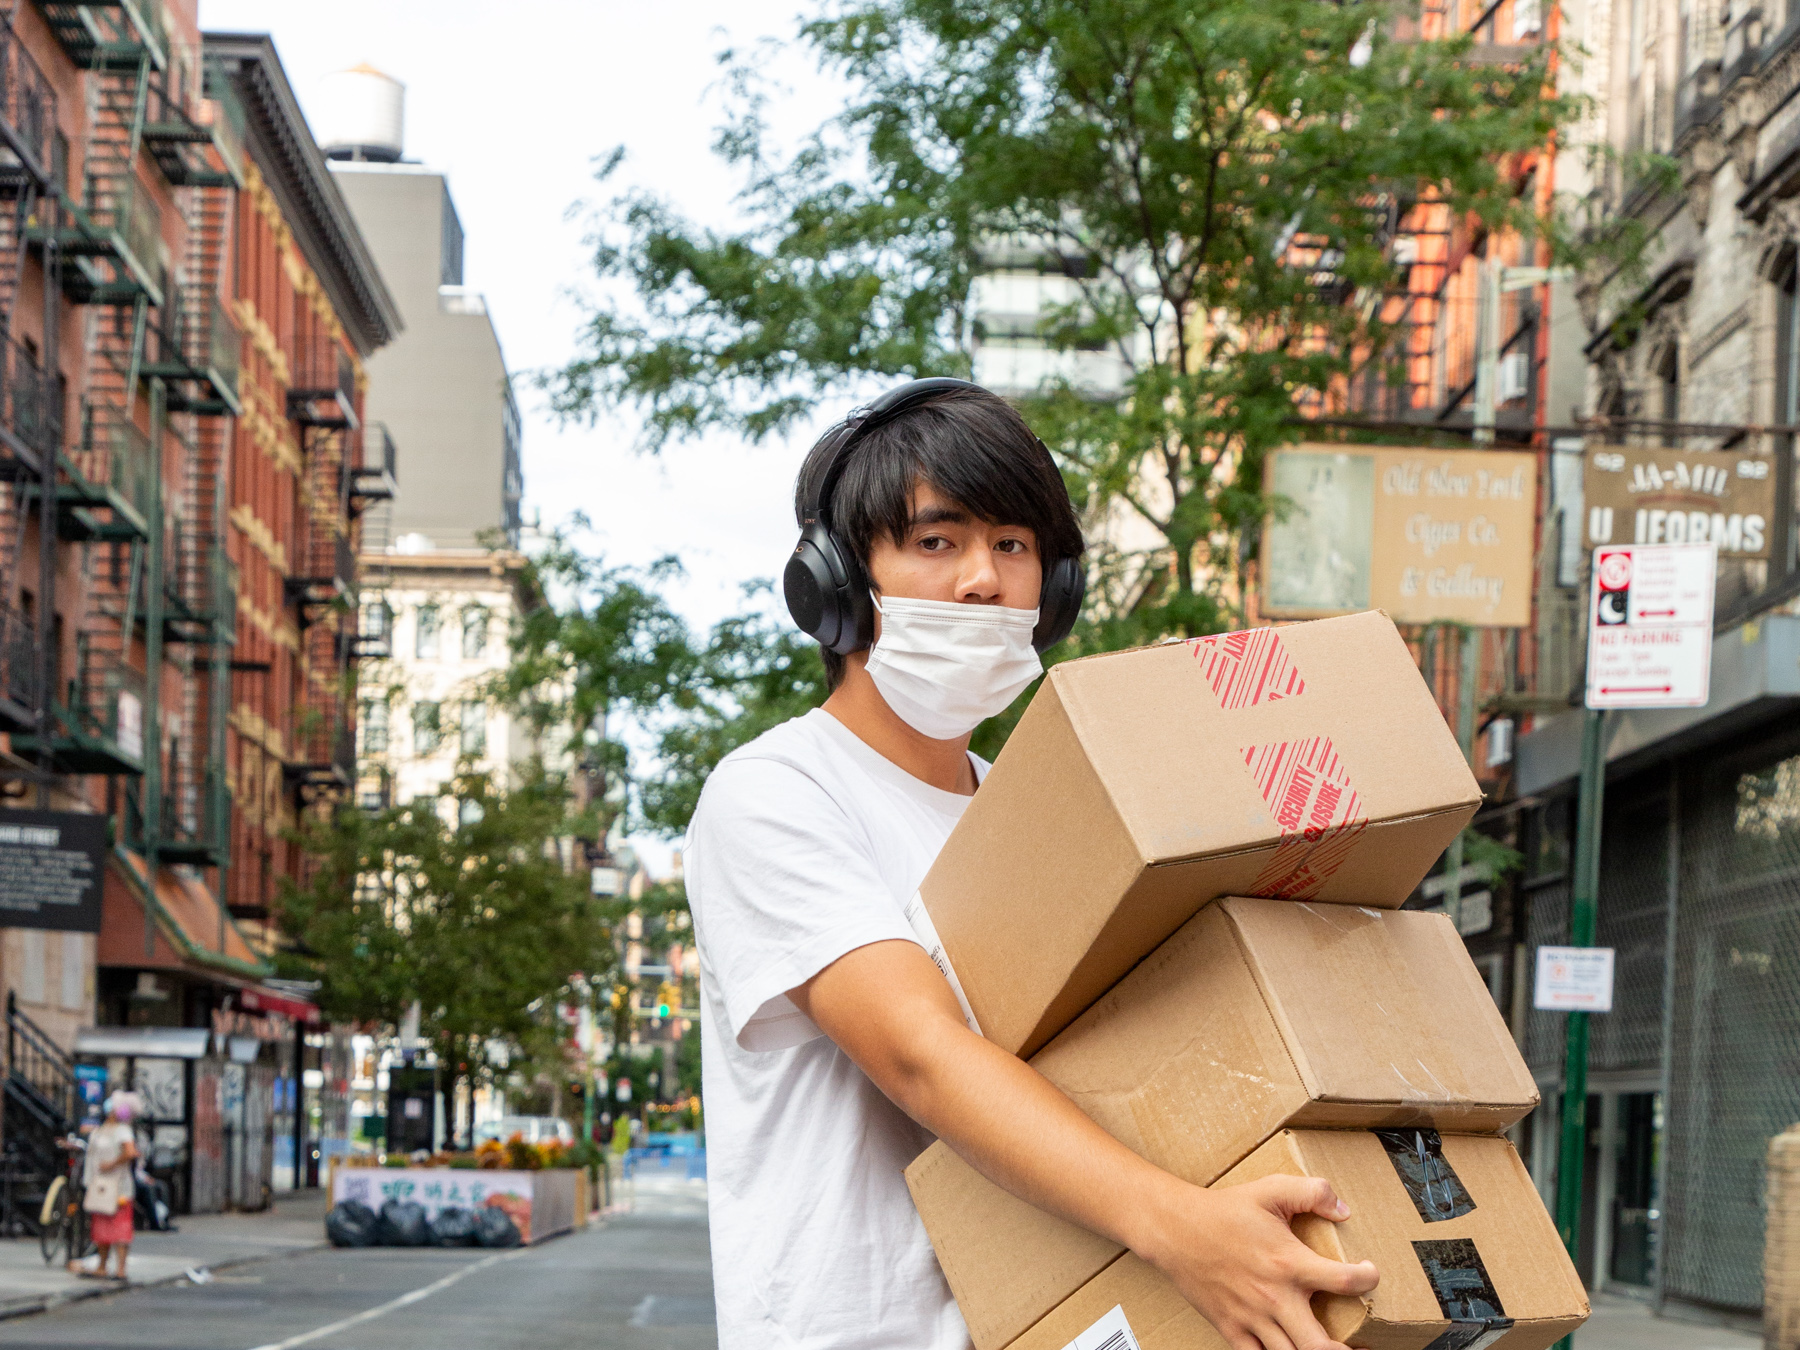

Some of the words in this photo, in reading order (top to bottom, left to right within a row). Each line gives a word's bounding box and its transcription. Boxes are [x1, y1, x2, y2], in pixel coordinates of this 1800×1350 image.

[1383, 460, 1422, 496] Old
[1427, 459, 1472, 497] New
[1476, 465, 1524, 498] York
[1405, 512, 1462, 558] Cigar
[1400, 565, 1425, 598] &
[1427, 563, 1505, 613] Gallery
[1277, 763, 1316, 832] SECURITY
[1303, 780, 1342, 844] CLOSURE
